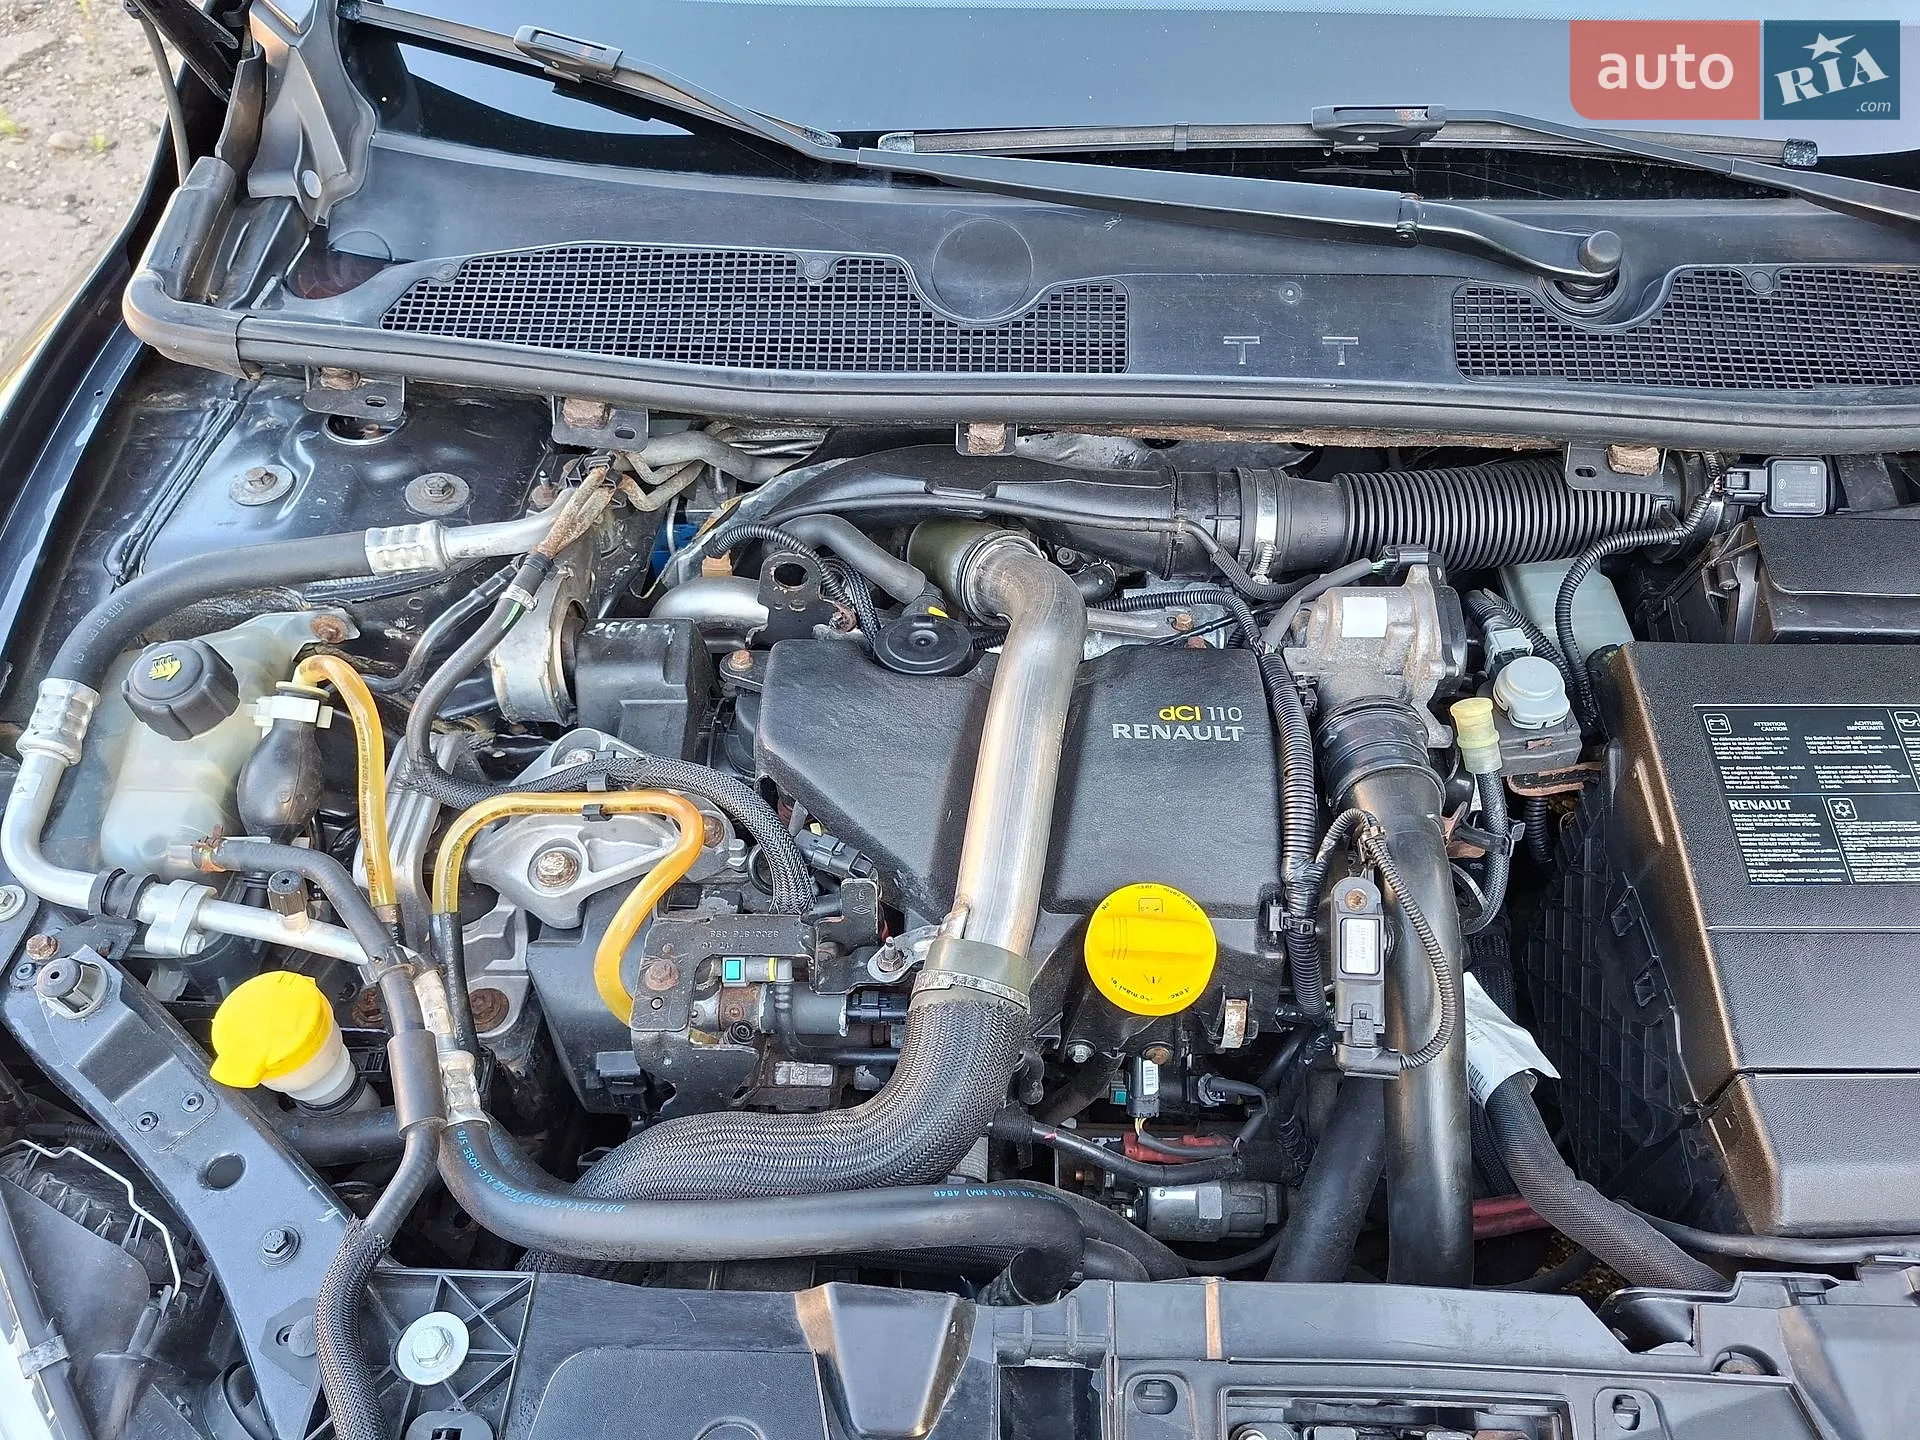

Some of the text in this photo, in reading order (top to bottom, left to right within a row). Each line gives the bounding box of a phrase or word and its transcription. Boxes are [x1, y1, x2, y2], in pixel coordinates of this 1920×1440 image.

[1207, 706, 1243, 722] 110
[1112, 723, 1245, 742] RENAULT
[1728, 800, 1791, 811] RENAULT
[463, 1147, 481, 1170] HOSE
[479, 1170, 496, 1184] A/C
[492, 1181, 560, 1208] GOODYEAR
[966, 1189, 987, 1198] MM)
